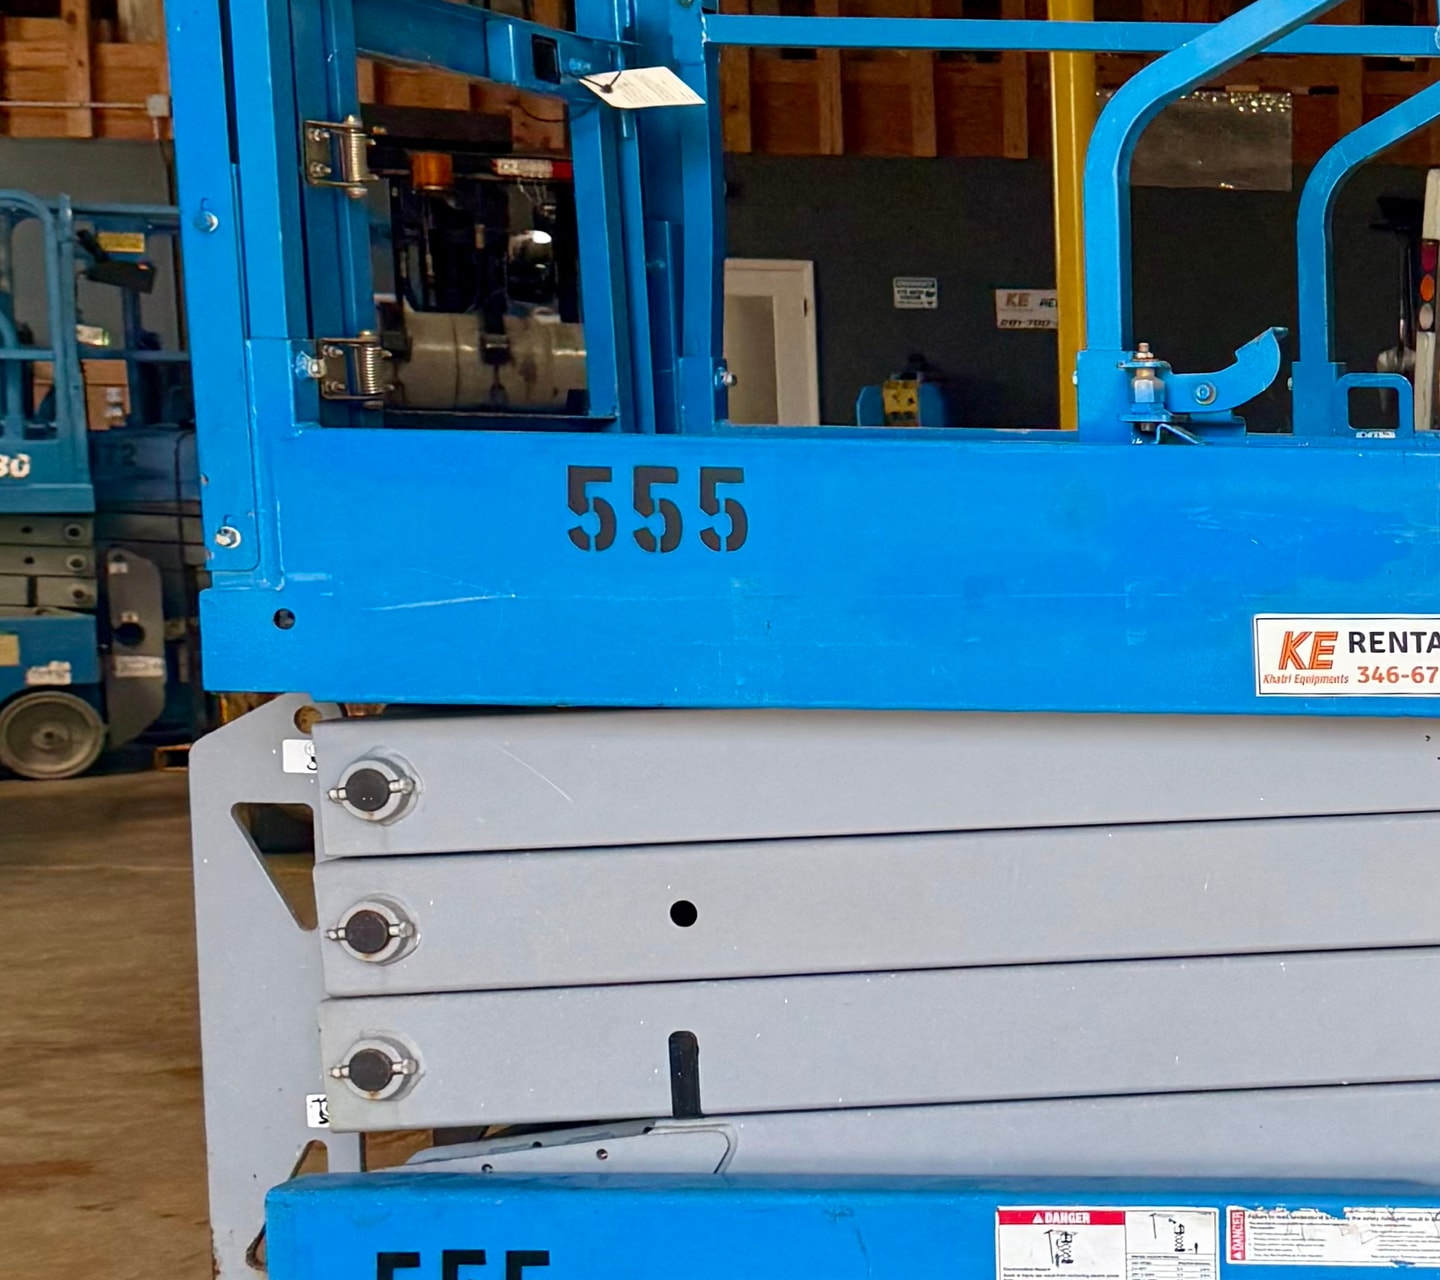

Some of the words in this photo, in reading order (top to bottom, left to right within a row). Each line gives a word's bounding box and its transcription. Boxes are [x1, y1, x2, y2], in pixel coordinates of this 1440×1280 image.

[567, 464, 748, 553] 555
[1278, 631, 1338, 670] KE
[1294, 674, 1349, 687] Equipments
[1045, 1212, 1090, 1224] DANGER
[1231, 1212, 1245, 1251] DANGER
